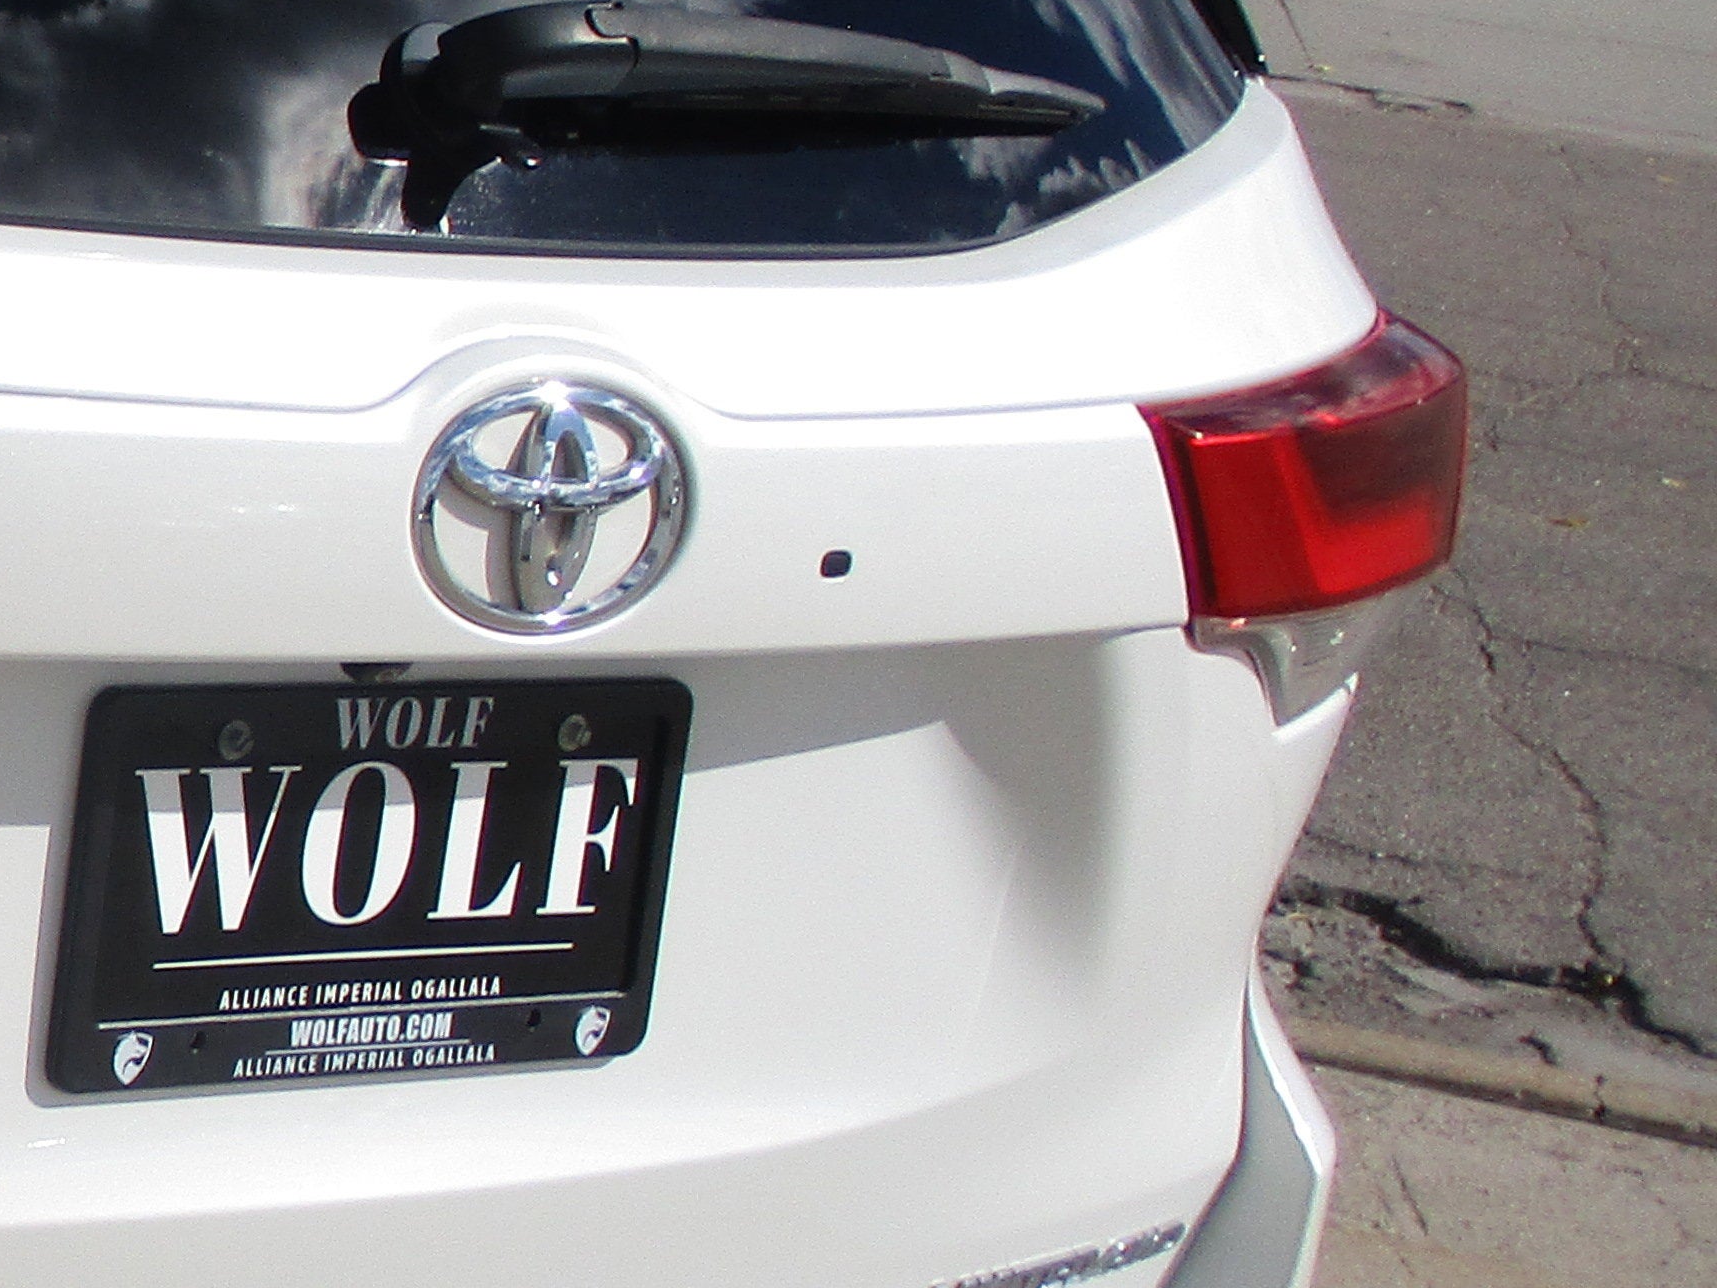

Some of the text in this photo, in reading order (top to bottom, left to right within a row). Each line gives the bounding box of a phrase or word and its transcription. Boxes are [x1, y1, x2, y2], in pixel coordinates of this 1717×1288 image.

[336, 695, 496, 751] WOLF
[134, 757, 640, 936] WOLF
[218, 974, 502, 1011] ALLIANCE IMPERIAL OGALLALA
[289, 1012, 455, 1048] WOLFAUTO.COM
[232, 1042, 496, 1079] ALLIANCE IMPERIAL OGALLALA
